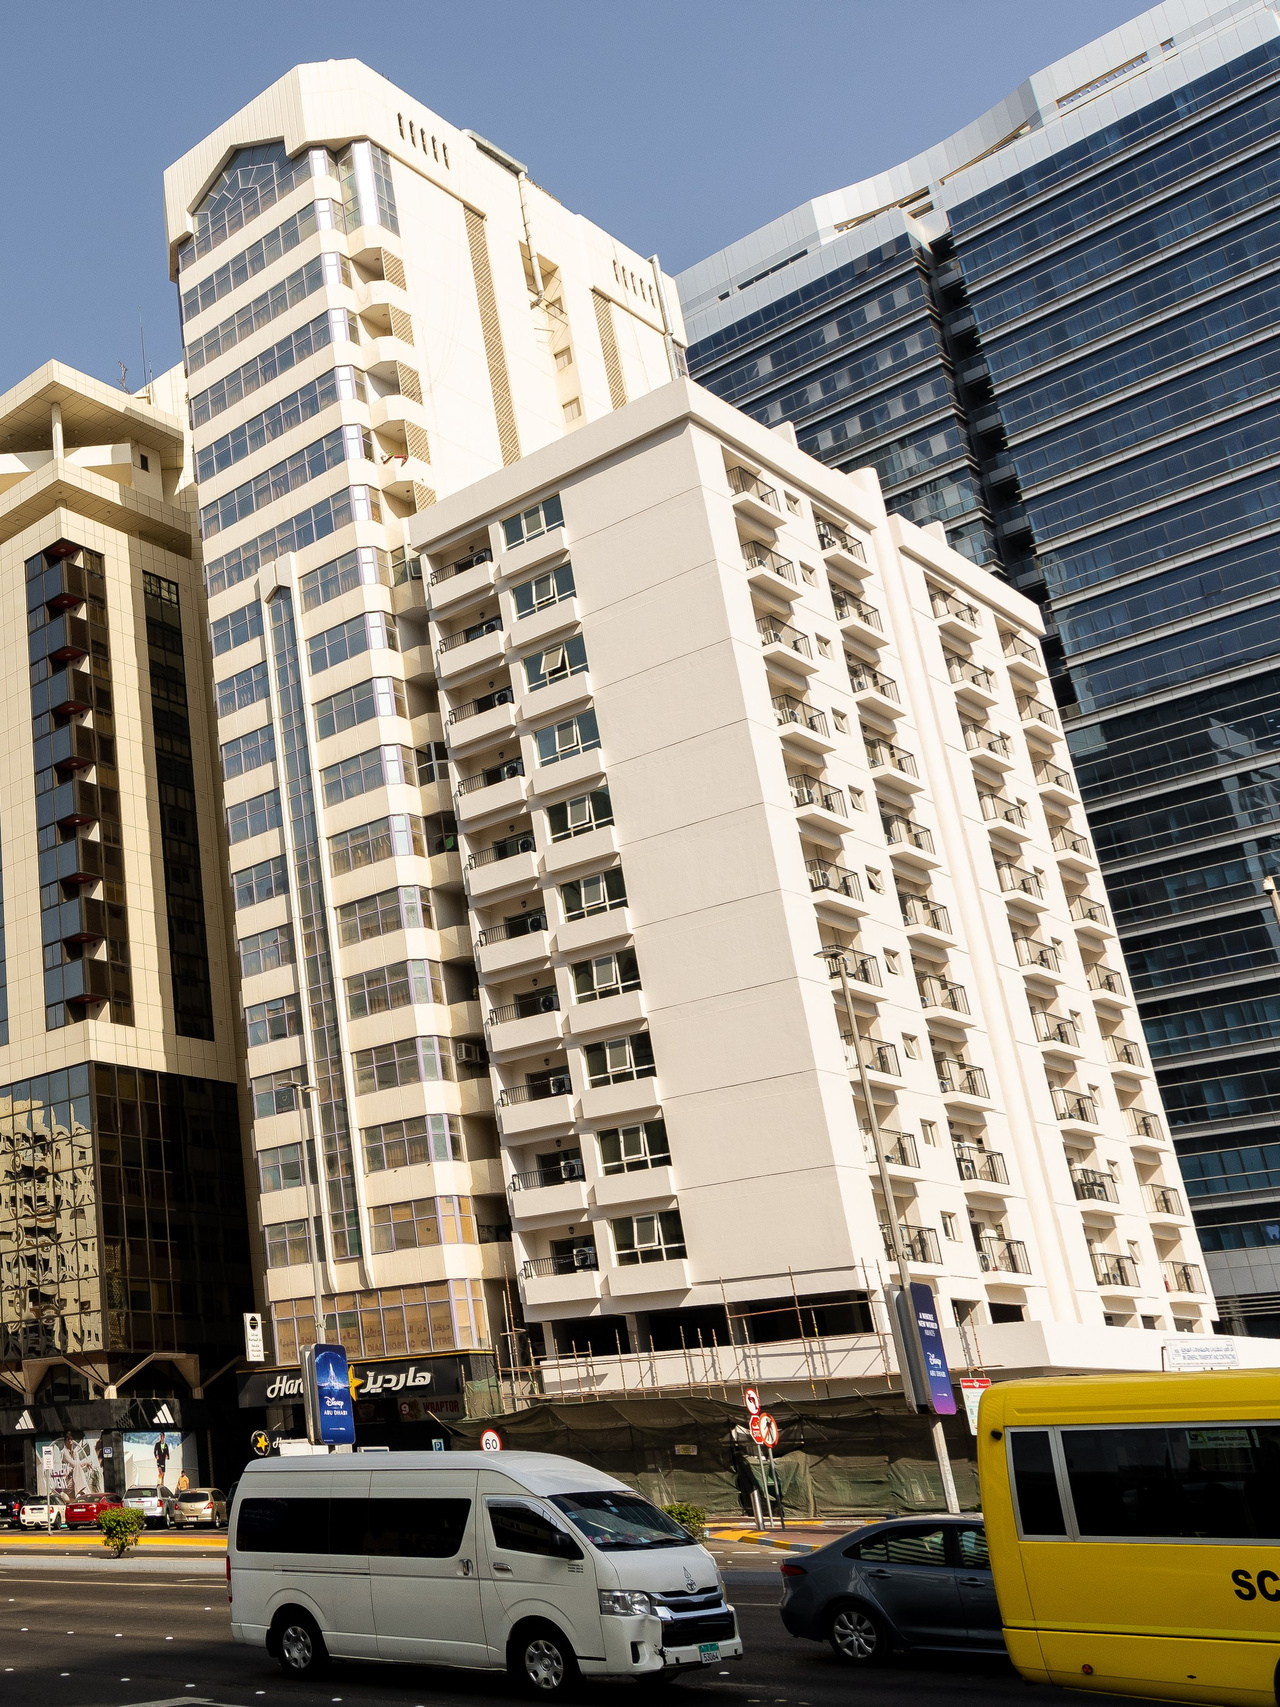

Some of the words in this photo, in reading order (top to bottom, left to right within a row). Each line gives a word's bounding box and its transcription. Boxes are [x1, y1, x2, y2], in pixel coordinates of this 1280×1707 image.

[360, 1366, 432, 1394] هارديز
[423, 1400, 460, 1414] WRAPTOR
[485, 1439, 498, 1450] 60
